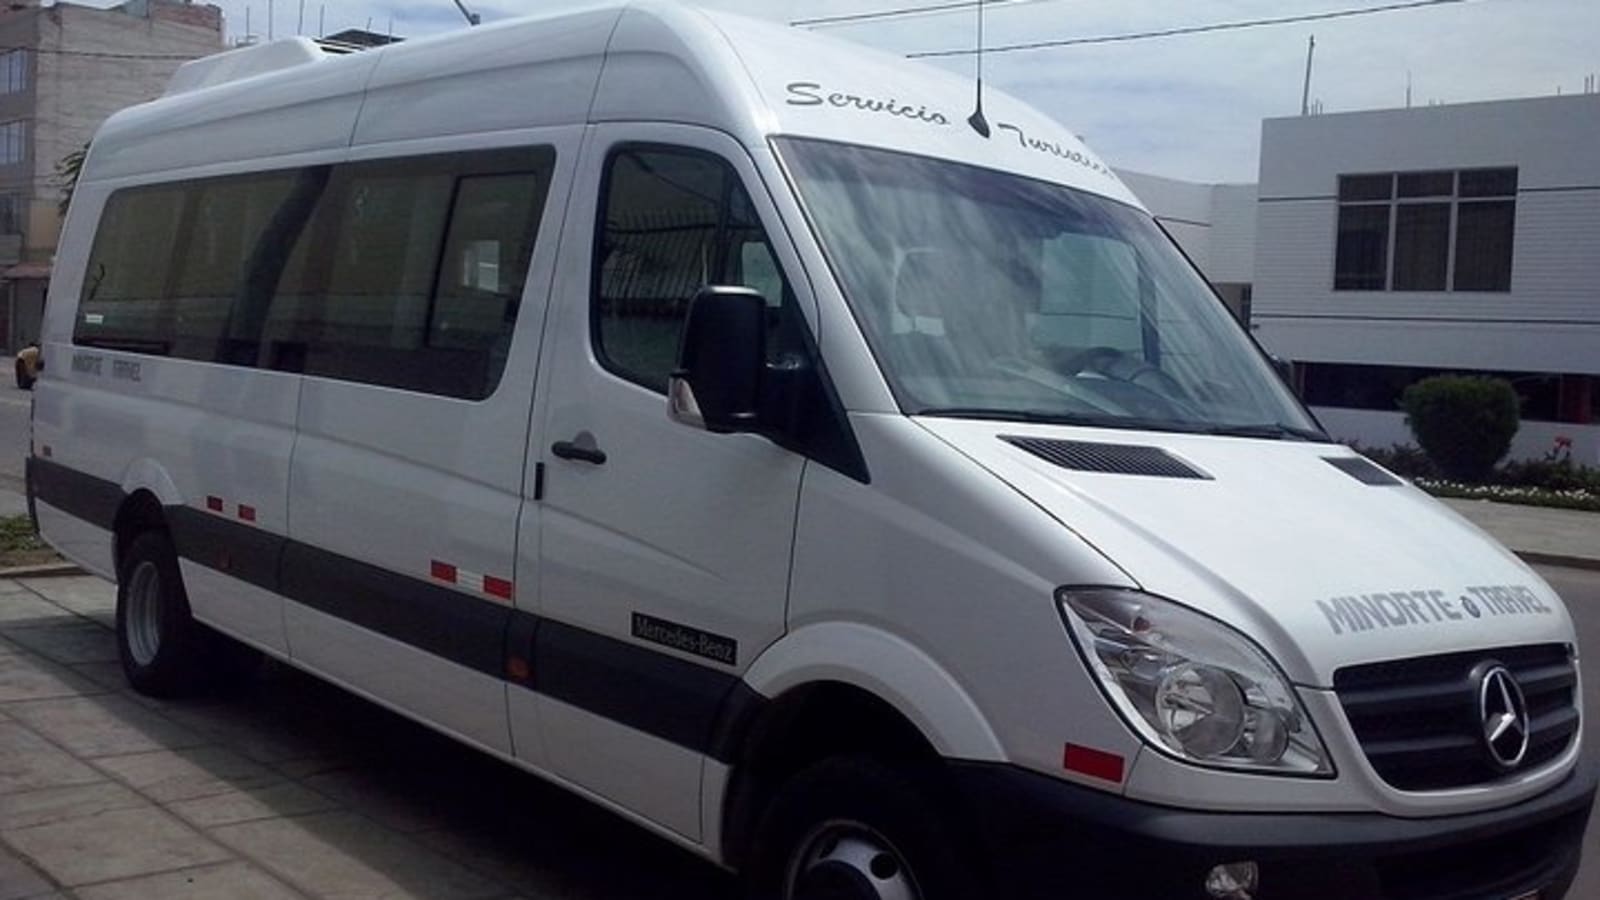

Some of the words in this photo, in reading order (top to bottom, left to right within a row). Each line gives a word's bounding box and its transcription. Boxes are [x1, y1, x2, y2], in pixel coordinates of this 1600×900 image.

[786, 82, 951, 125] Servicio
[1316, 590, 1463, 635] MINORTE
[634, 614, 734, 662] Mercedes-Benz
